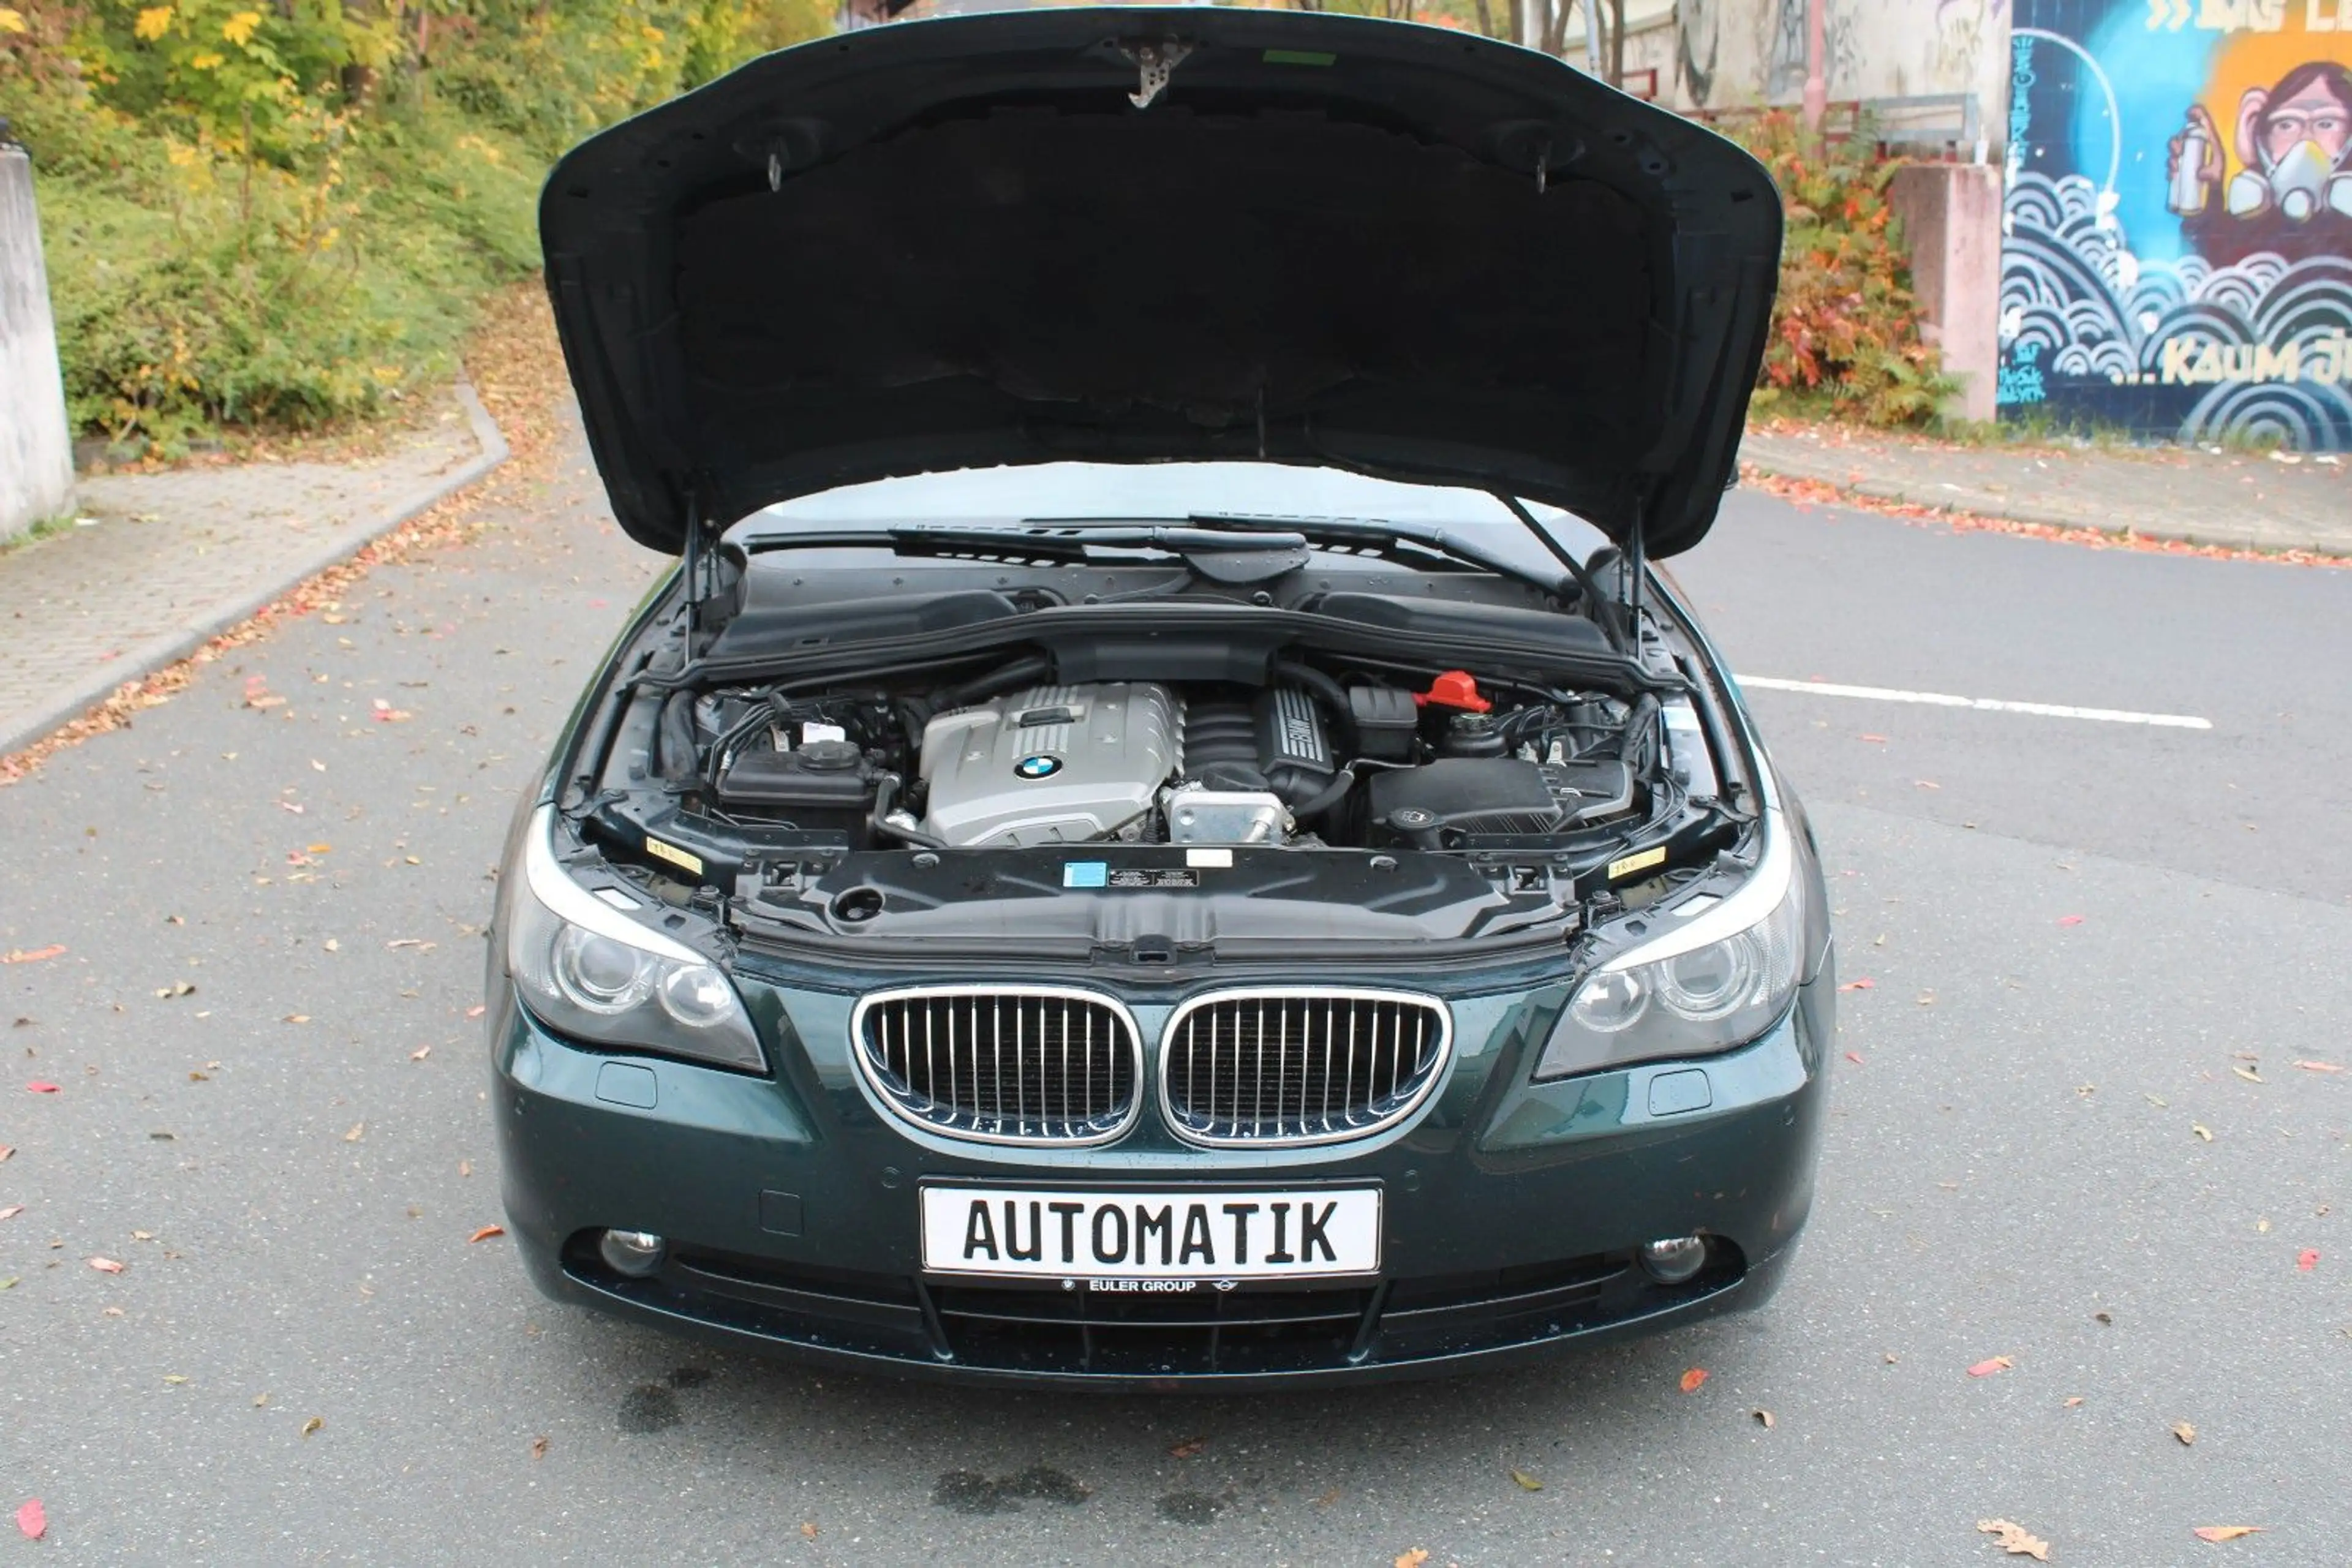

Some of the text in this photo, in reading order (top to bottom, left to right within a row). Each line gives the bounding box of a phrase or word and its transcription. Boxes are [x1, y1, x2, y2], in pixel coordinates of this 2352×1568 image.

[963, 1199, 1338, 1265] AUTOMATIK
[1089, 1280, 1196, 1292] EULER GROUP
